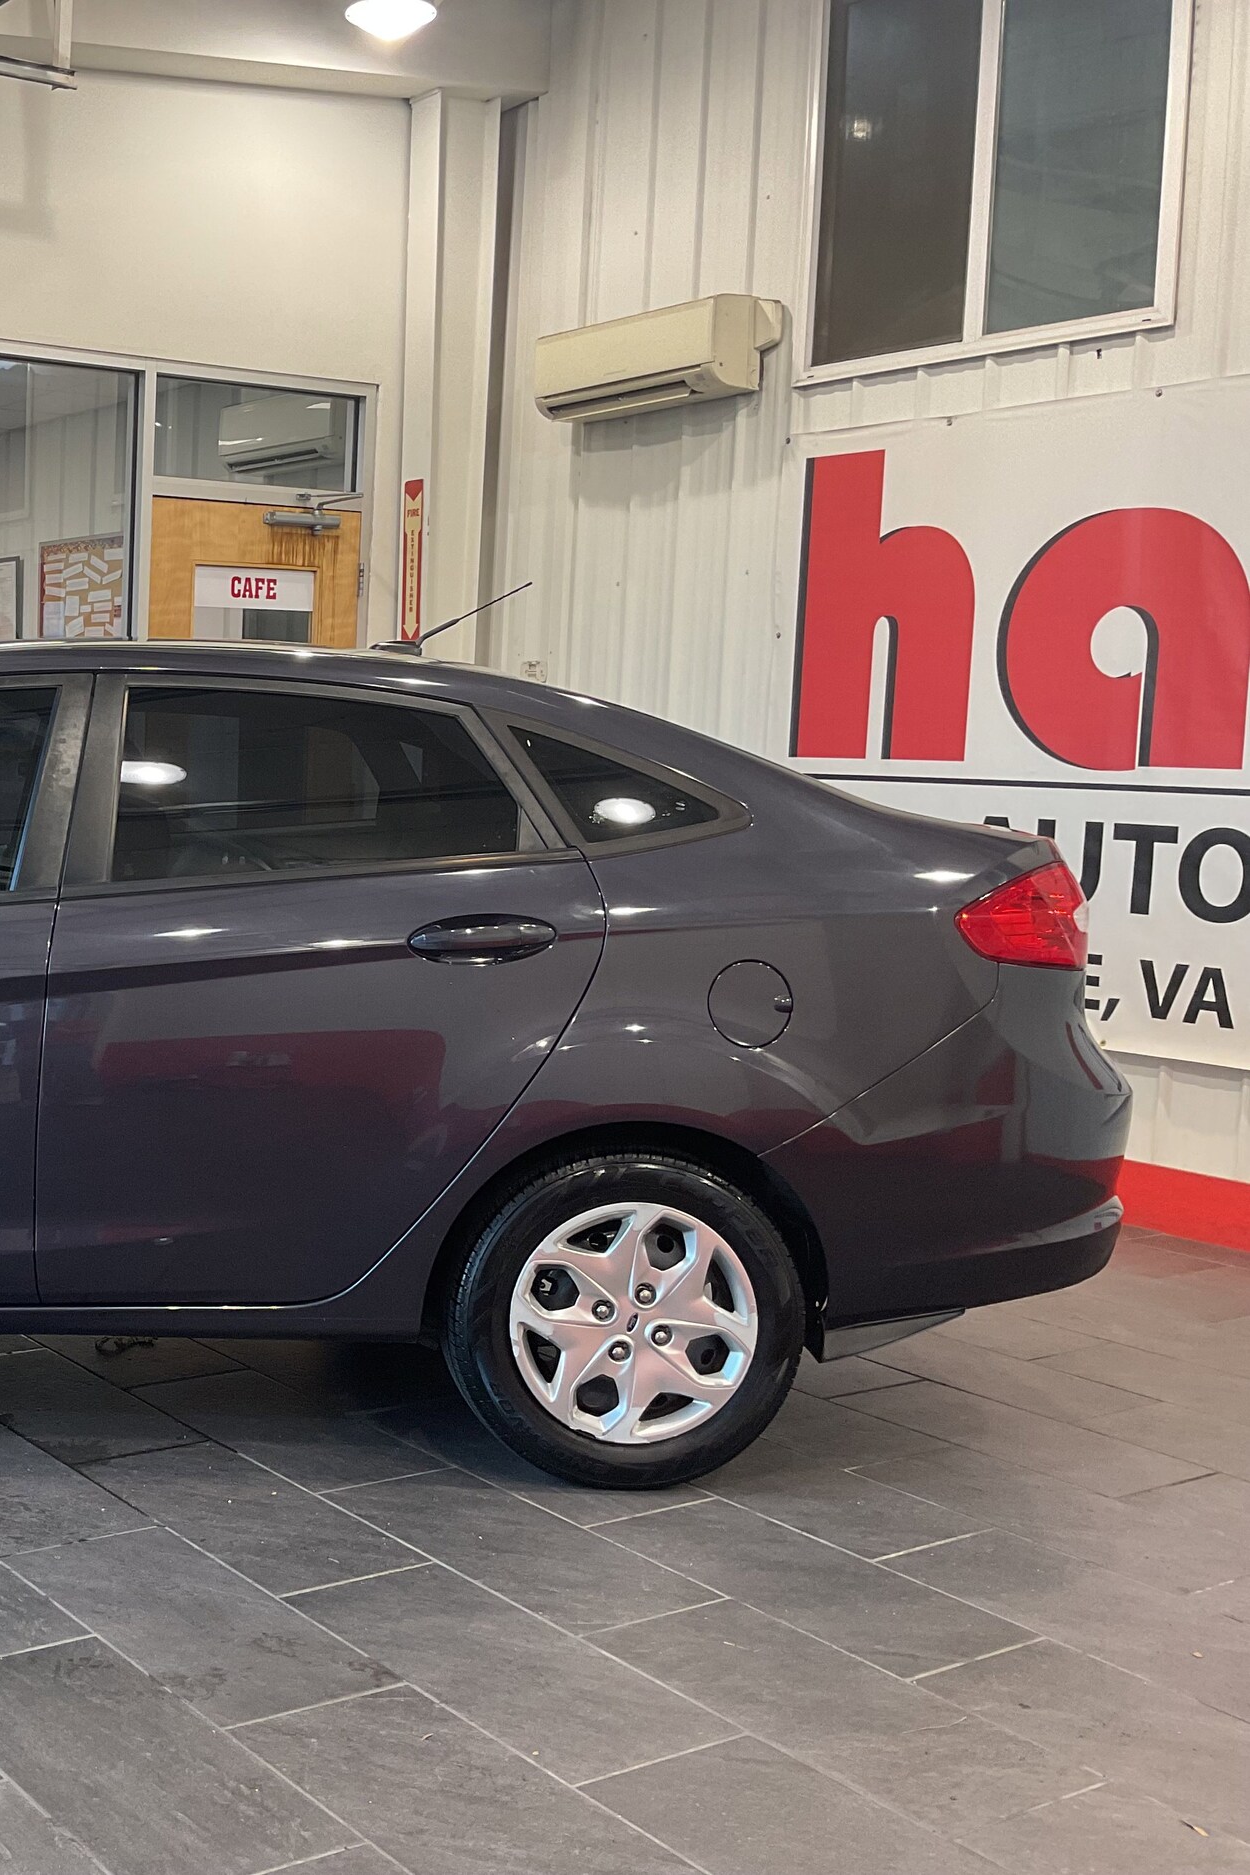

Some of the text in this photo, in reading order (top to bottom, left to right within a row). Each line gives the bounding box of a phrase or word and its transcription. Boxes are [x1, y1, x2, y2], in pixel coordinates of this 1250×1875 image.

[407, 508, 420, 518] FIRE
[230, 576, 277, 600] CAFE
[982, 816, 1250, 924] UTO
[1139, 958, 1235, 1030] VA
